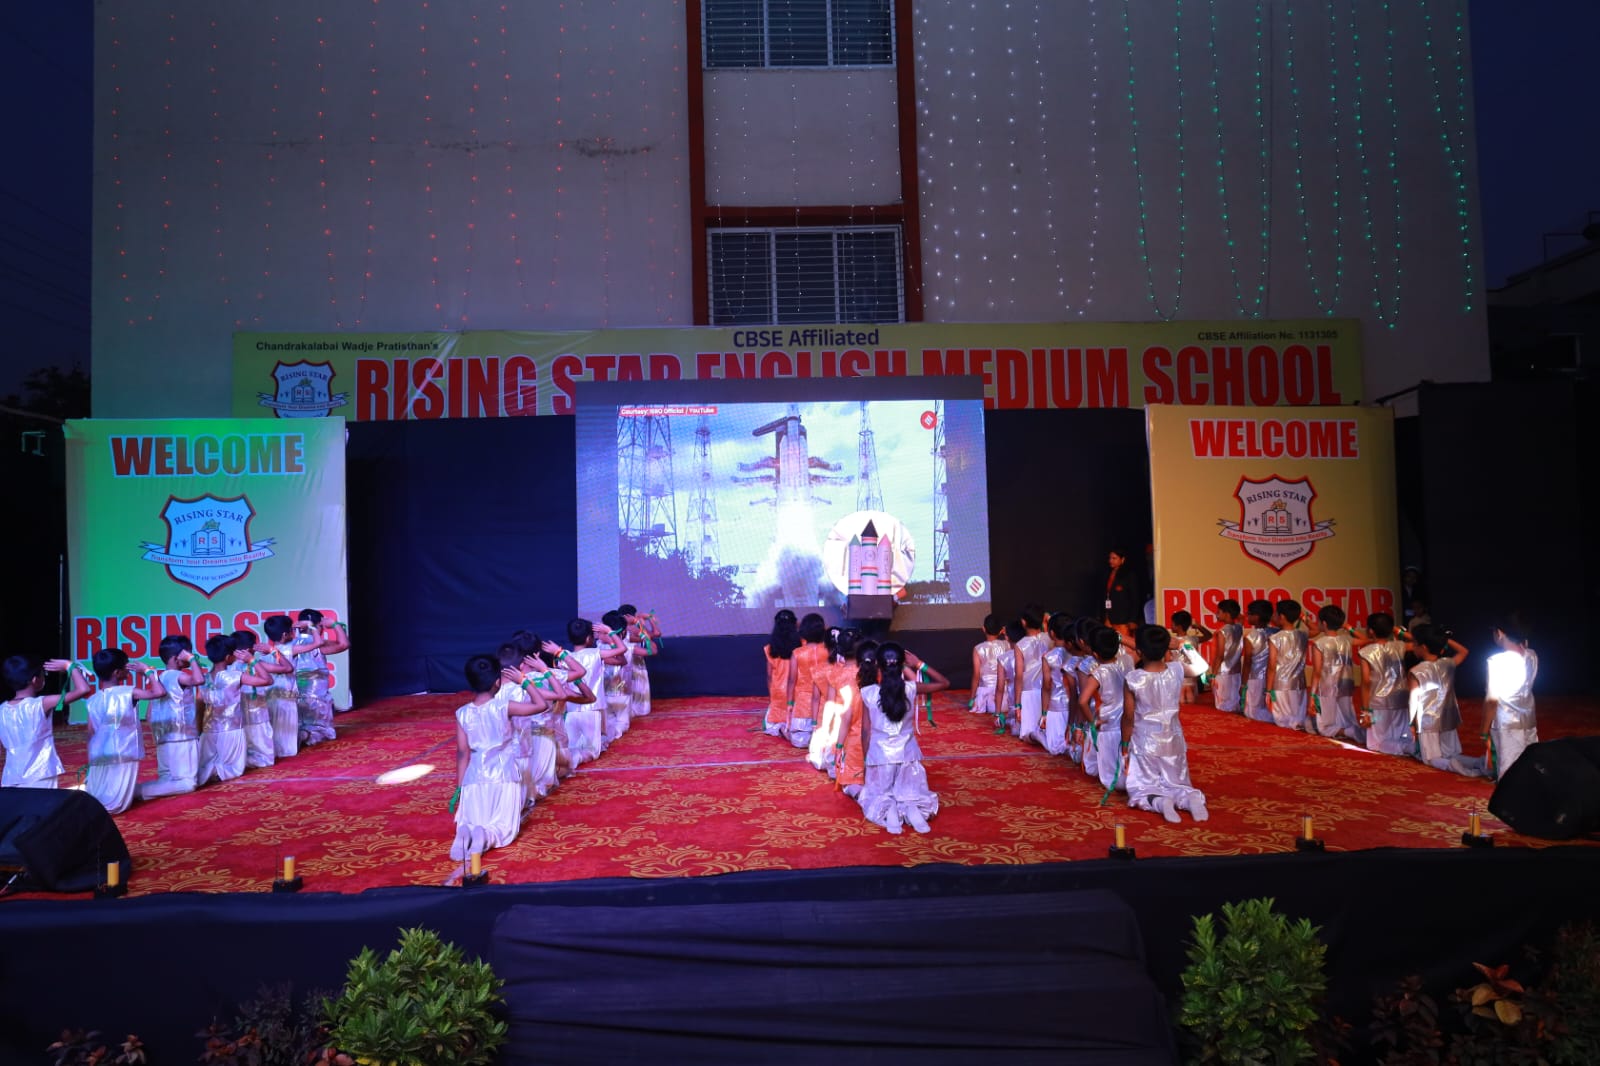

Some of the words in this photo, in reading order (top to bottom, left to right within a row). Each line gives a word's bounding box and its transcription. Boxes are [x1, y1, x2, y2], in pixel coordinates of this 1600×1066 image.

[256, 341, 339, 351] Chandrakalabai
[341, 341, 372, 352] Wadje
[377, 340, 439, 351] Pratisthan's
[733, 330, 783, 348] CBSE
[788, 328, 880, 347] Affiliated
[1198, 331, 1225, 341] CBSE
[1229, 331, 1276, 340] Affiliation
[356, 354, 537, 421] RISING
[1142, 344, 1342, 407] SCHOOL
[1190, 418, 1359, 459] WELCOME
[110, 434, 305, 477] WELCOME
[1246, 489, 1281, 505] RISING
[1282, 490, 1308, 504] STAR
[174, 509, 214, 525] RISING
[216, 509, 244, 523] STAR
[1163, 588, 1292, 631] RIS
